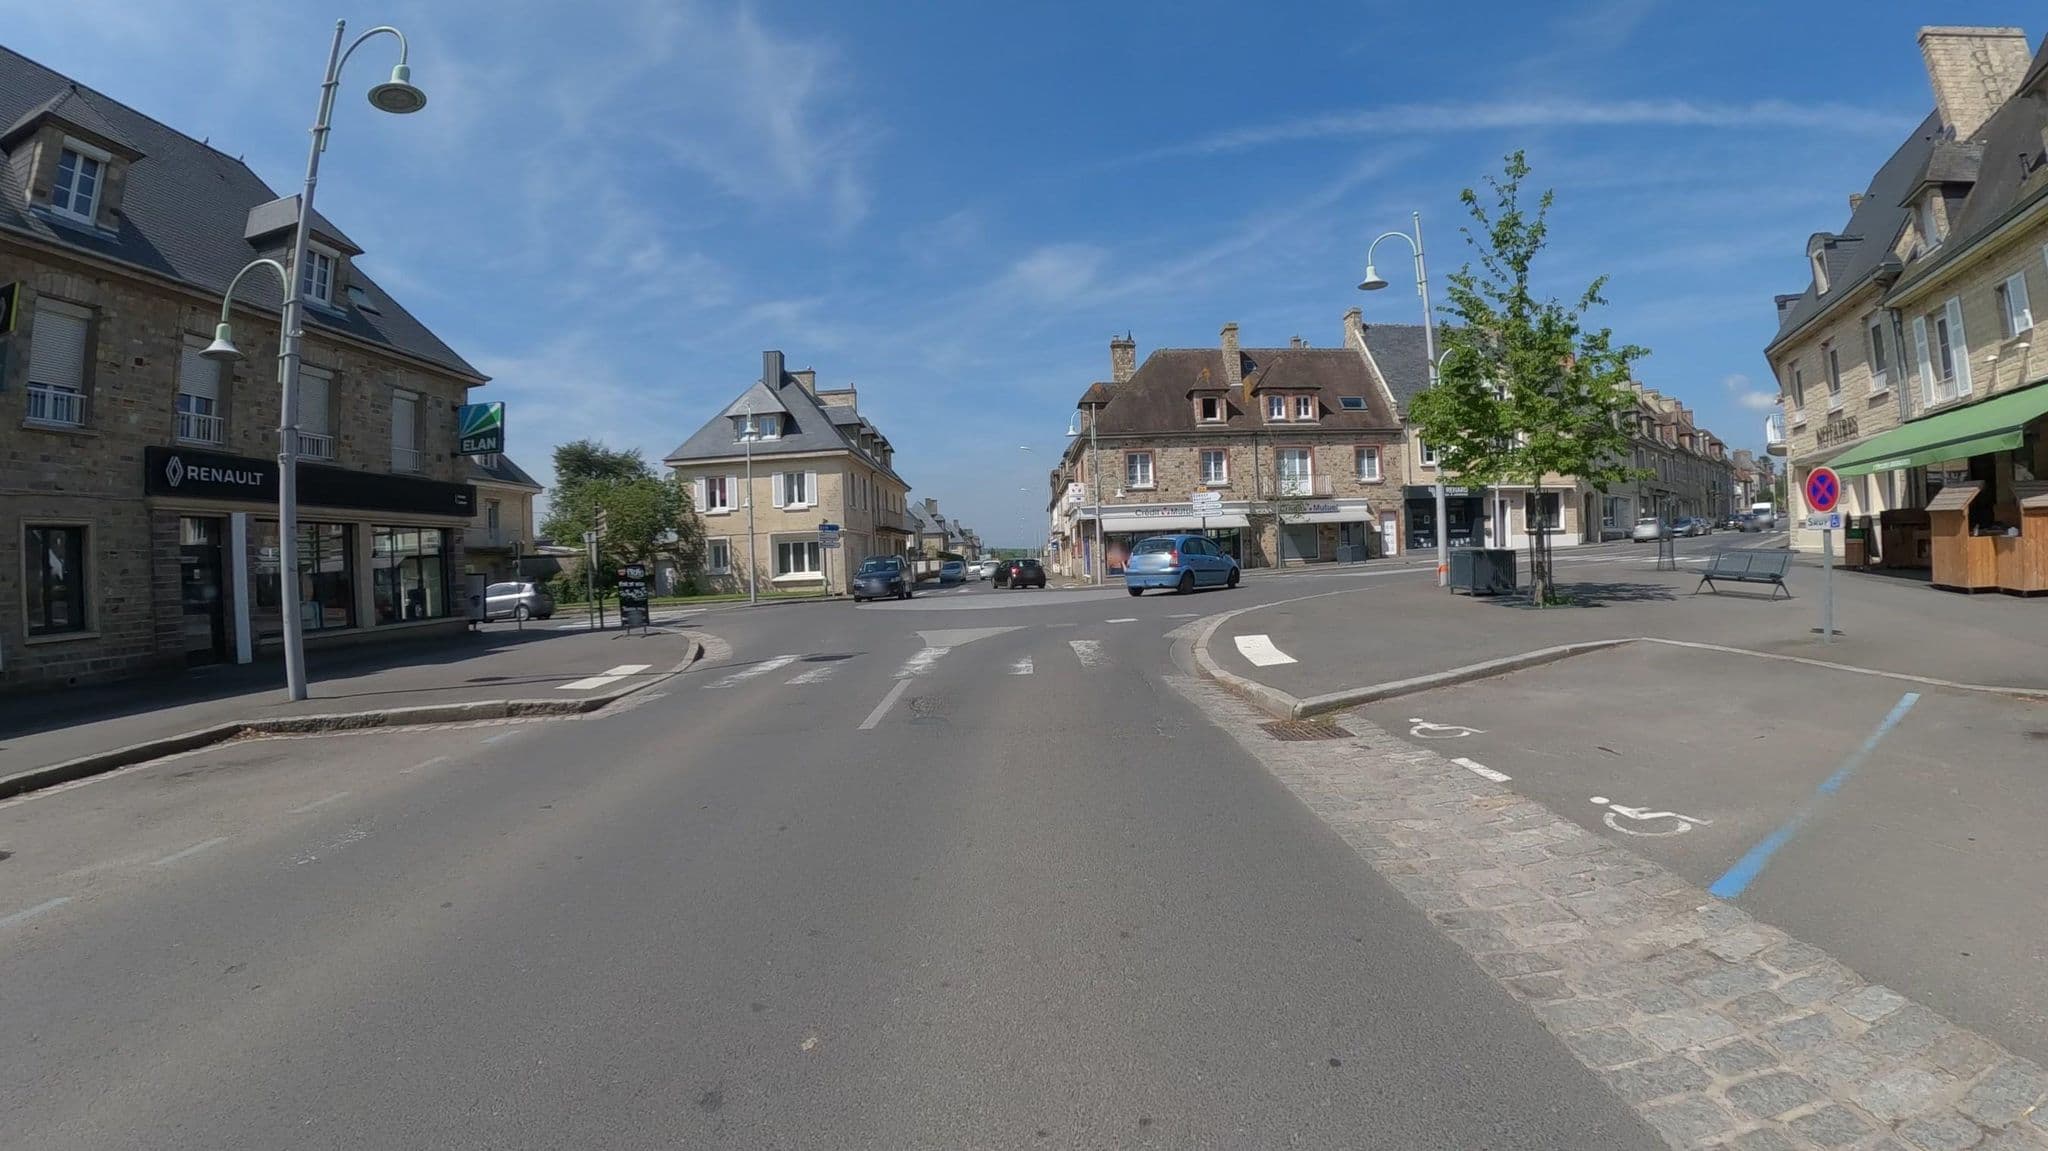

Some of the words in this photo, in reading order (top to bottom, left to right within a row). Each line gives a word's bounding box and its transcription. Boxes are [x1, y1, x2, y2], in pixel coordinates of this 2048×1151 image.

[1817, 415, 1858, 447] NOTAIRES
[463, 438, 497, 452] ELAN
[187, 465, 264, 486] RENAULT
